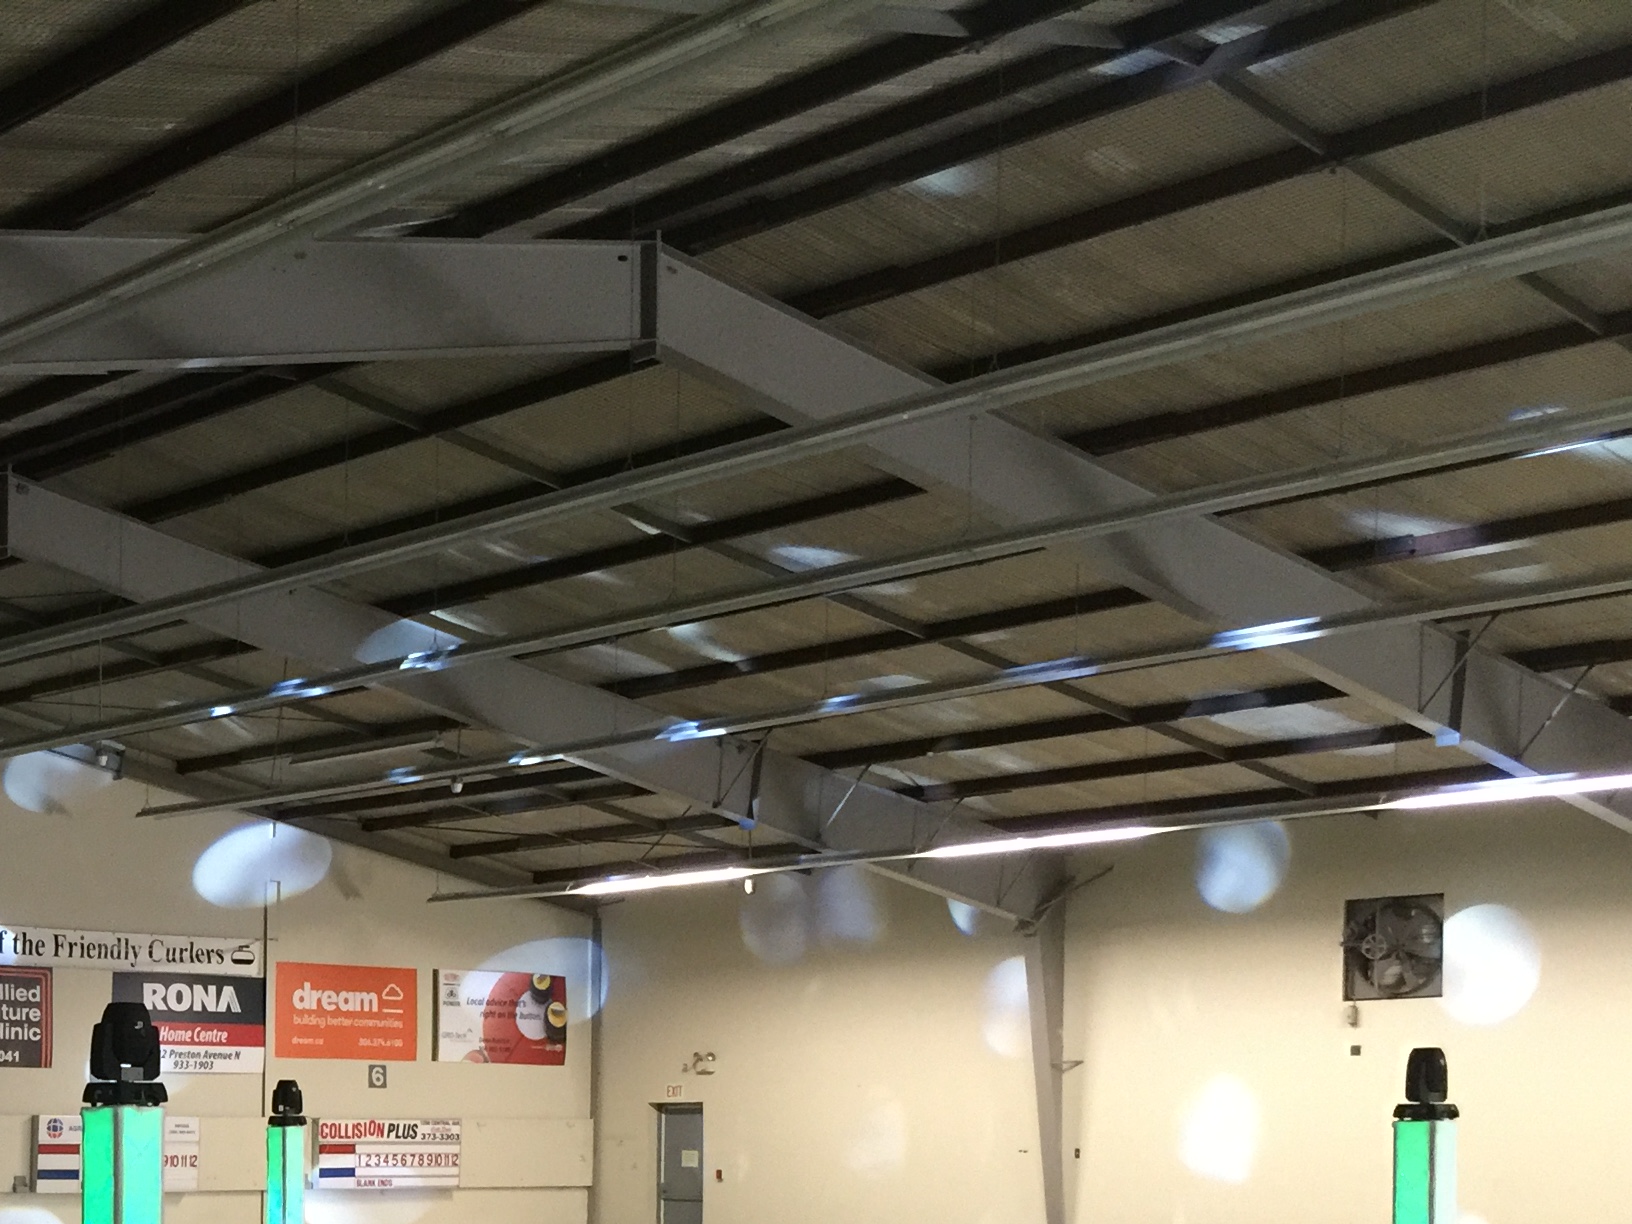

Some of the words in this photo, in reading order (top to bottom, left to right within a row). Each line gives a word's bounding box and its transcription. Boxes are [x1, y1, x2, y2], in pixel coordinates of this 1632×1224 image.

[12, 930, 44, 957] the
[52, 934, 141, 968] Friendly
[148, 939, 225, 965] Curlers
[143, 982, 242, 1013] RONA
[292, 982, 379, 1012] dream
[293, 1014, 326, 1028] building
[327, 1015, 353, 1026] better
[353, 1017, 404, 1028] communities
[159, 1025, 192, 1042] Home
[193, 1026, 229, 1043] Centre
[169, 1049, 201, 1060] Preston
[203, 1050, 233, 1060] Avenue
[234, 1051, 241, 1060] N
[173, 1060, 214, 1070] 933-1903
[371, 1066, 384, 1086] 6
[666, 1085, 682, 1097] EXIT
[320, 1120, 385, 1140] COLLISION
[387, 1123, 419, 1140] PLUS
[170, 1155, 180, 1167] 10
[181, 1155, 188, 1167] 11
[189, 1154, 198, 1167] 12
[357, 1154, 362, 1167] 1
[365, 1154, 372, 1167] 2
[374, 1154, 381, 1167] 3
[383, 1154, 389, 1167] 4
[392, 1154, 399, 1167] 5
[400, 1154, 407, 1167] 6
[410, 1154, 416, 1167] 7
[418, 1154, 424, 1167] 8
[426, 1154, 433, 1167] 9
[434, 1154, 443, 1167] 10
[444, 1154, 450, 1167] 11
[451, 1154, 459, 1167] 12
